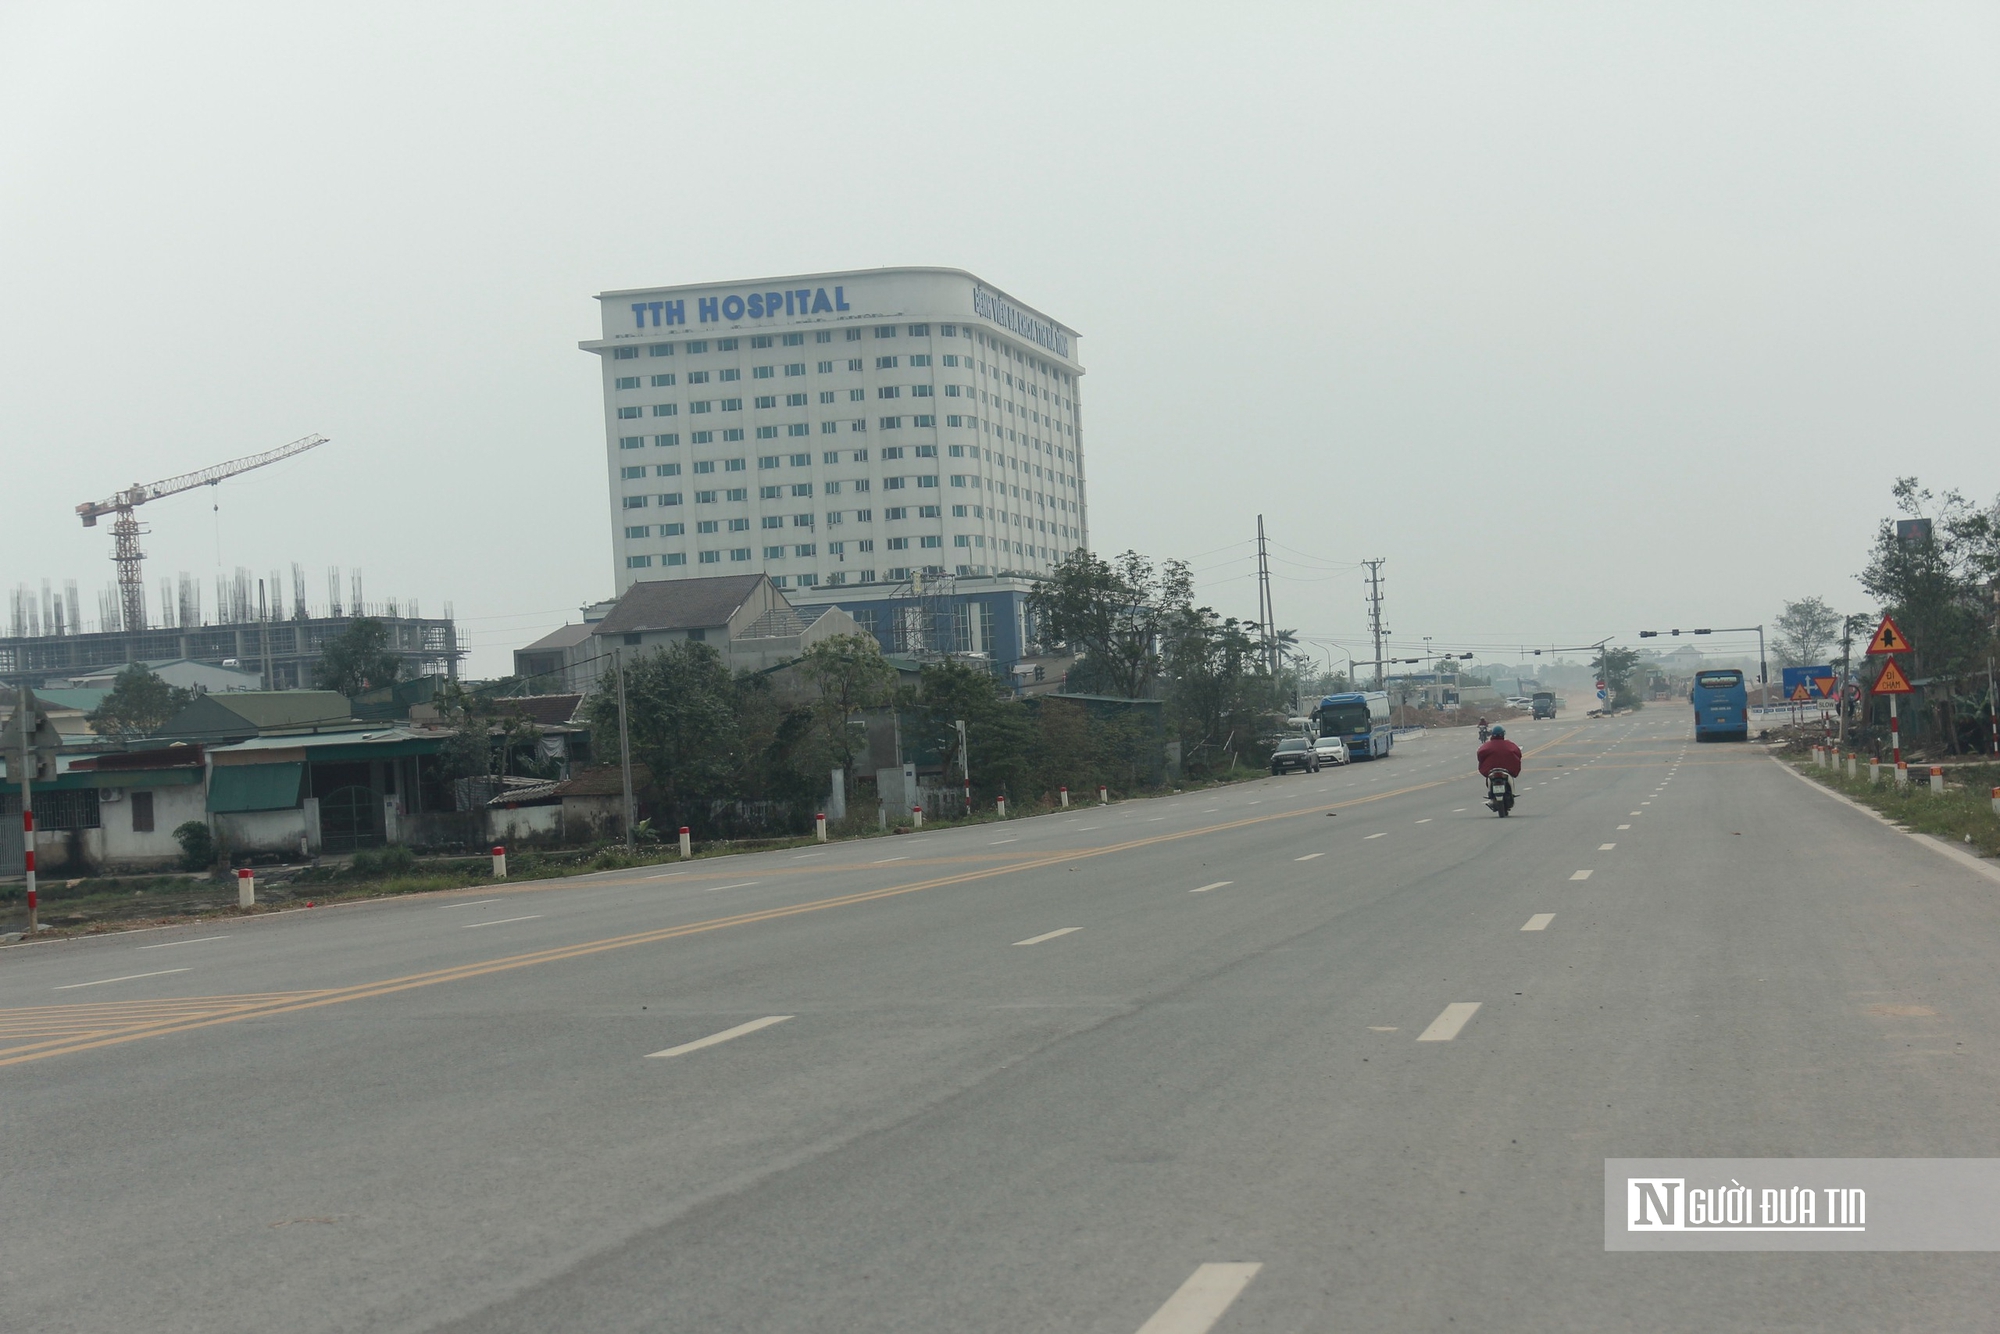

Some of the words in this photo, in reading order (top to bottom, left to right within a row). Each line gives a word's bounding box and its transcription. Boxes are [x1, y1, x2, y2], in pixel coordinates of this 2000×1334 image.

[631, 299, 686, 328] TTH
[698, 286, 850, 323] HOSPITAL
[1017, 312, 1035, 341] KHOA
